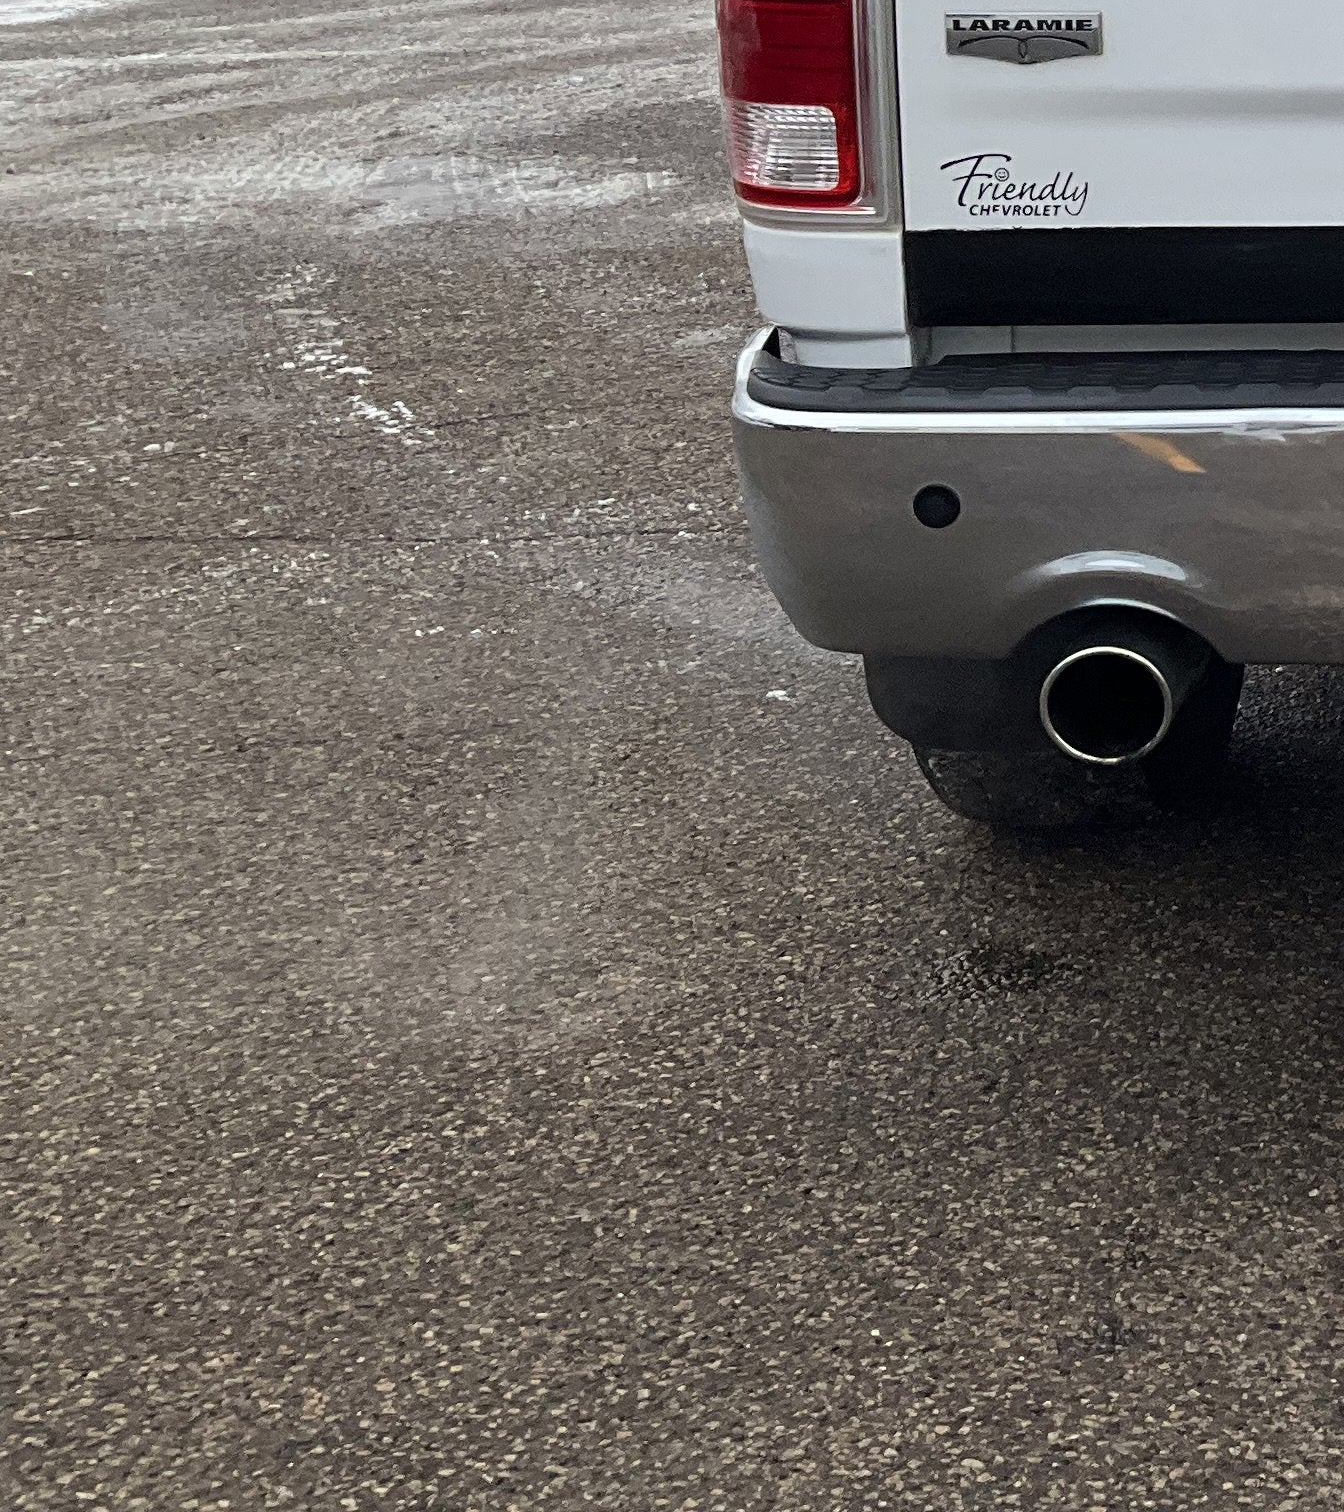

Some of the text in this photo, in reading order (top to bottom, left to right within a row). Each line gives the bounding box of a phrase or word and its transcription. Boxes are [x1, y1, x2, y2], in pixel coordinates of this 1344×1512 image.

[952, 18, 1094, 32] LARAMIE
[940, 153, 1089, 217] Friendly
[969, 203, 1062, 217] CHEVROLET
